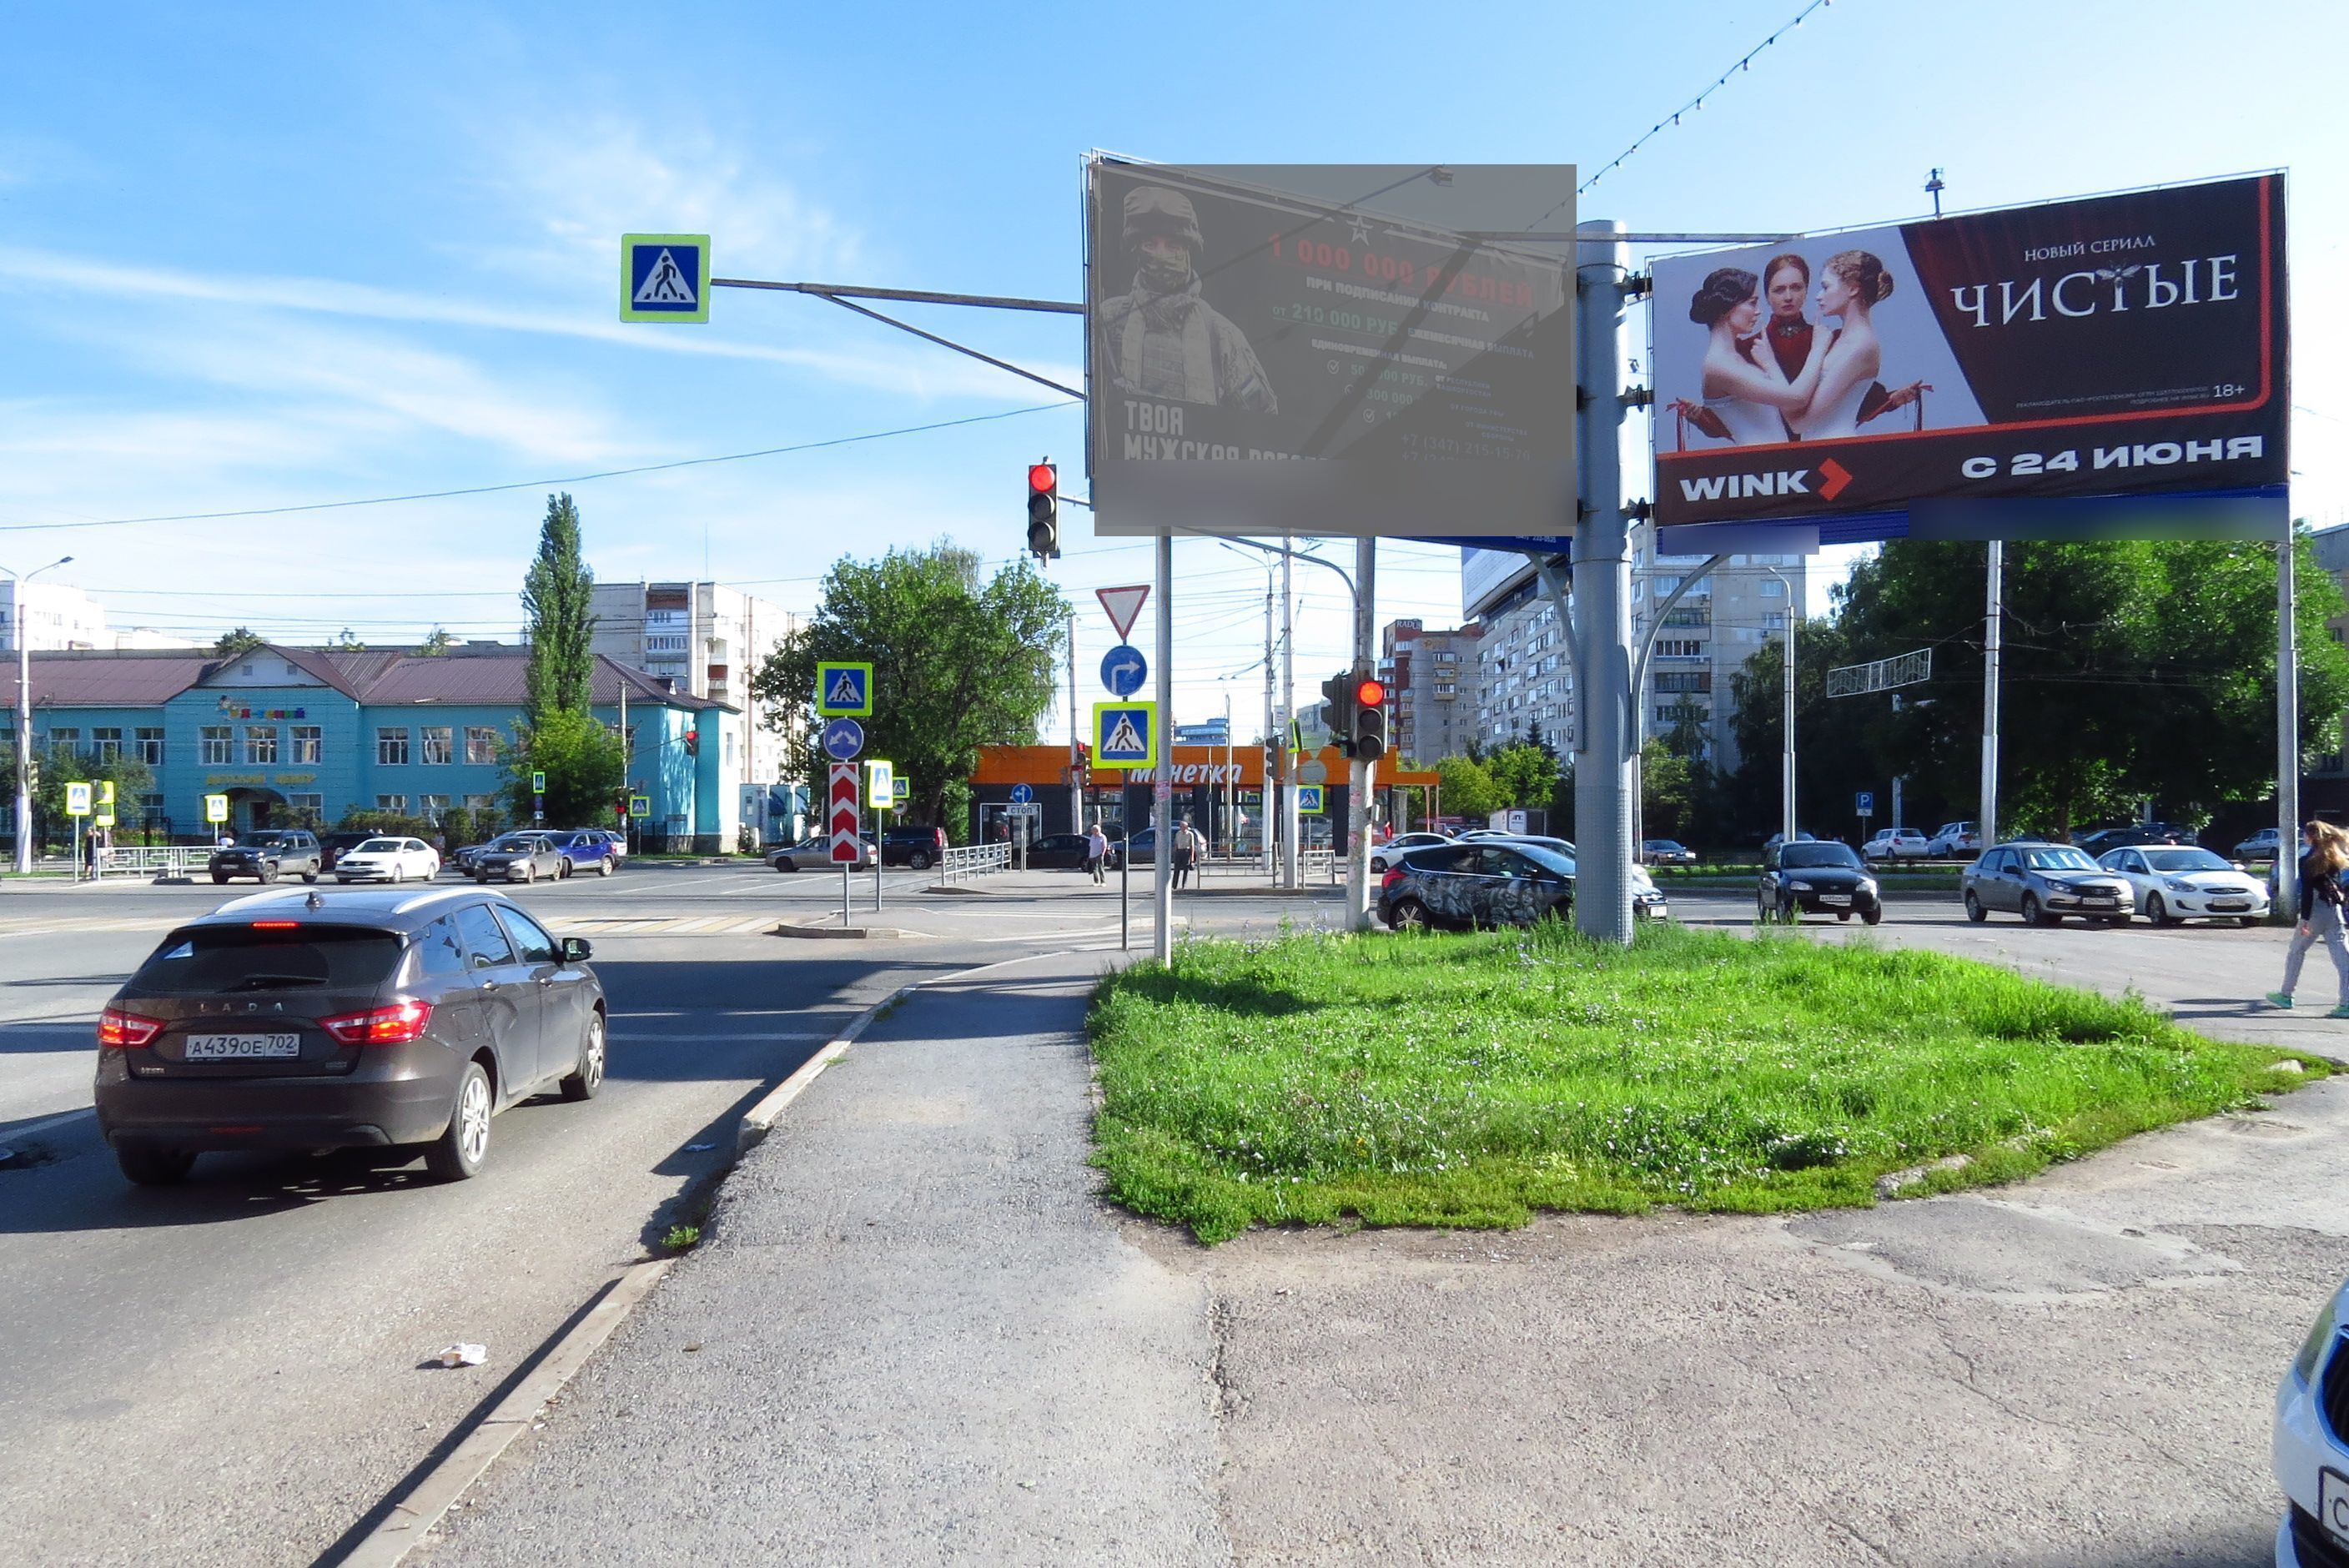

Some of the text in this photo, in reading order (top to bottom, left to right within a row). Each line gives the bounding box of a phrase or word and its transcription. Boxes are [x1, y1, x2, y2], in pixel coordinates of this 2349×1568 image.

[2024, 234, 2156, 263] НОВЫЙ СЕРИАЛ
[1269, 234, 1533, 308] 1 000 000 РУБЛЕЙ
[1306, 276, 1490, 323] ПРИ ПОДПИСАНИИ КОНТРАКТА
[1950, 254, 2238, 327] ЧИСТЫЕ
[1311, 338, 1401, 362] ЕДИНОВРЕМЕННАЯ
[1330, 310, 1361, 330] 000
[1407, 328, 1485, 351] ЕЖЕМЕСЯЧНАЯ
[1486, 342, 1536, 360] ВЫПЛАТА
[2212, 381, 2246, 400] 18+
[1124, 400, 1185, 436] ТВОЯ
[1962, 435, 2263, 479] С 24 ИЮНЯ
[1680, 469, 1810, 502] WINK
[267, 1035, 296, 1049] 702
